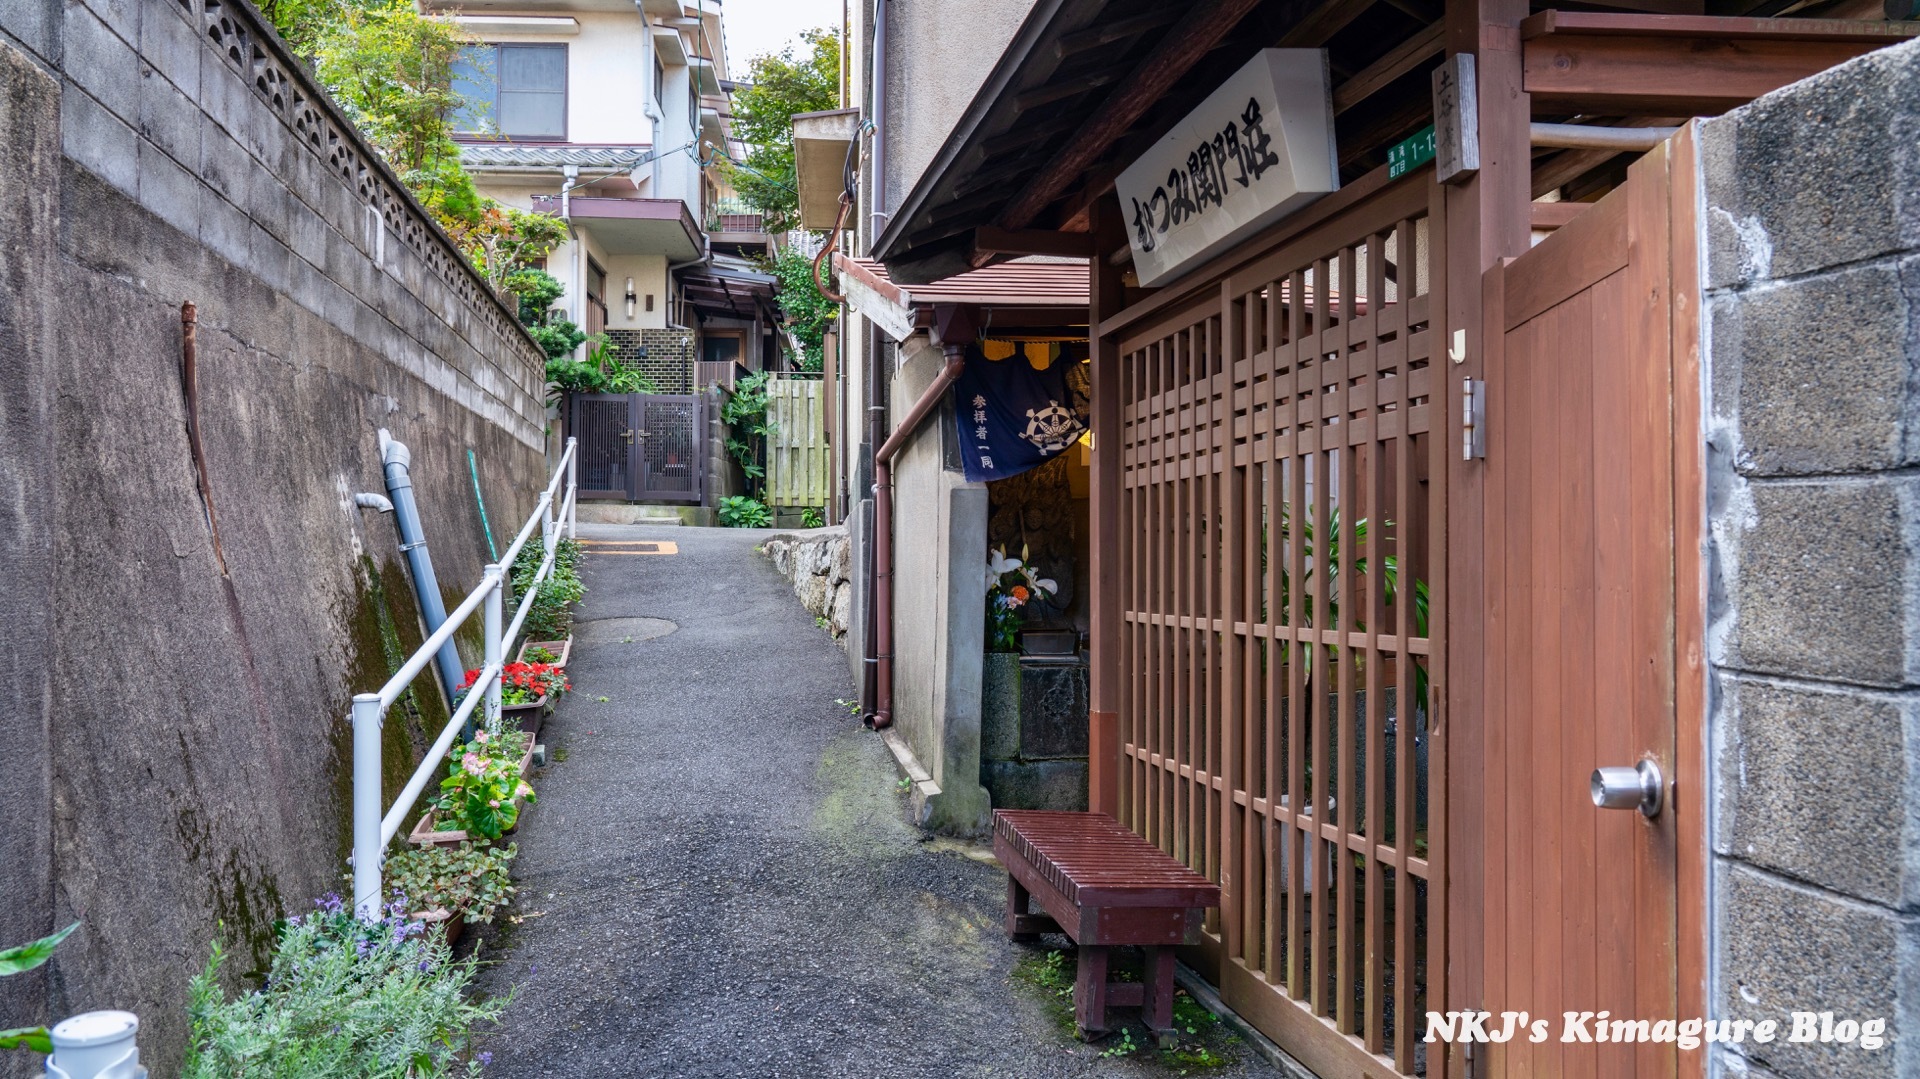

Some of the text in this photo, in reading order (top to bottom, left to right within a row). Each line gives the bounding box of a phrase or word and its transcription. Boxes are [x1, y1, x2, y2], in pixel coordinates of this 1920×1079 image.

[972, 394, 994, 469] 参拝者一同
